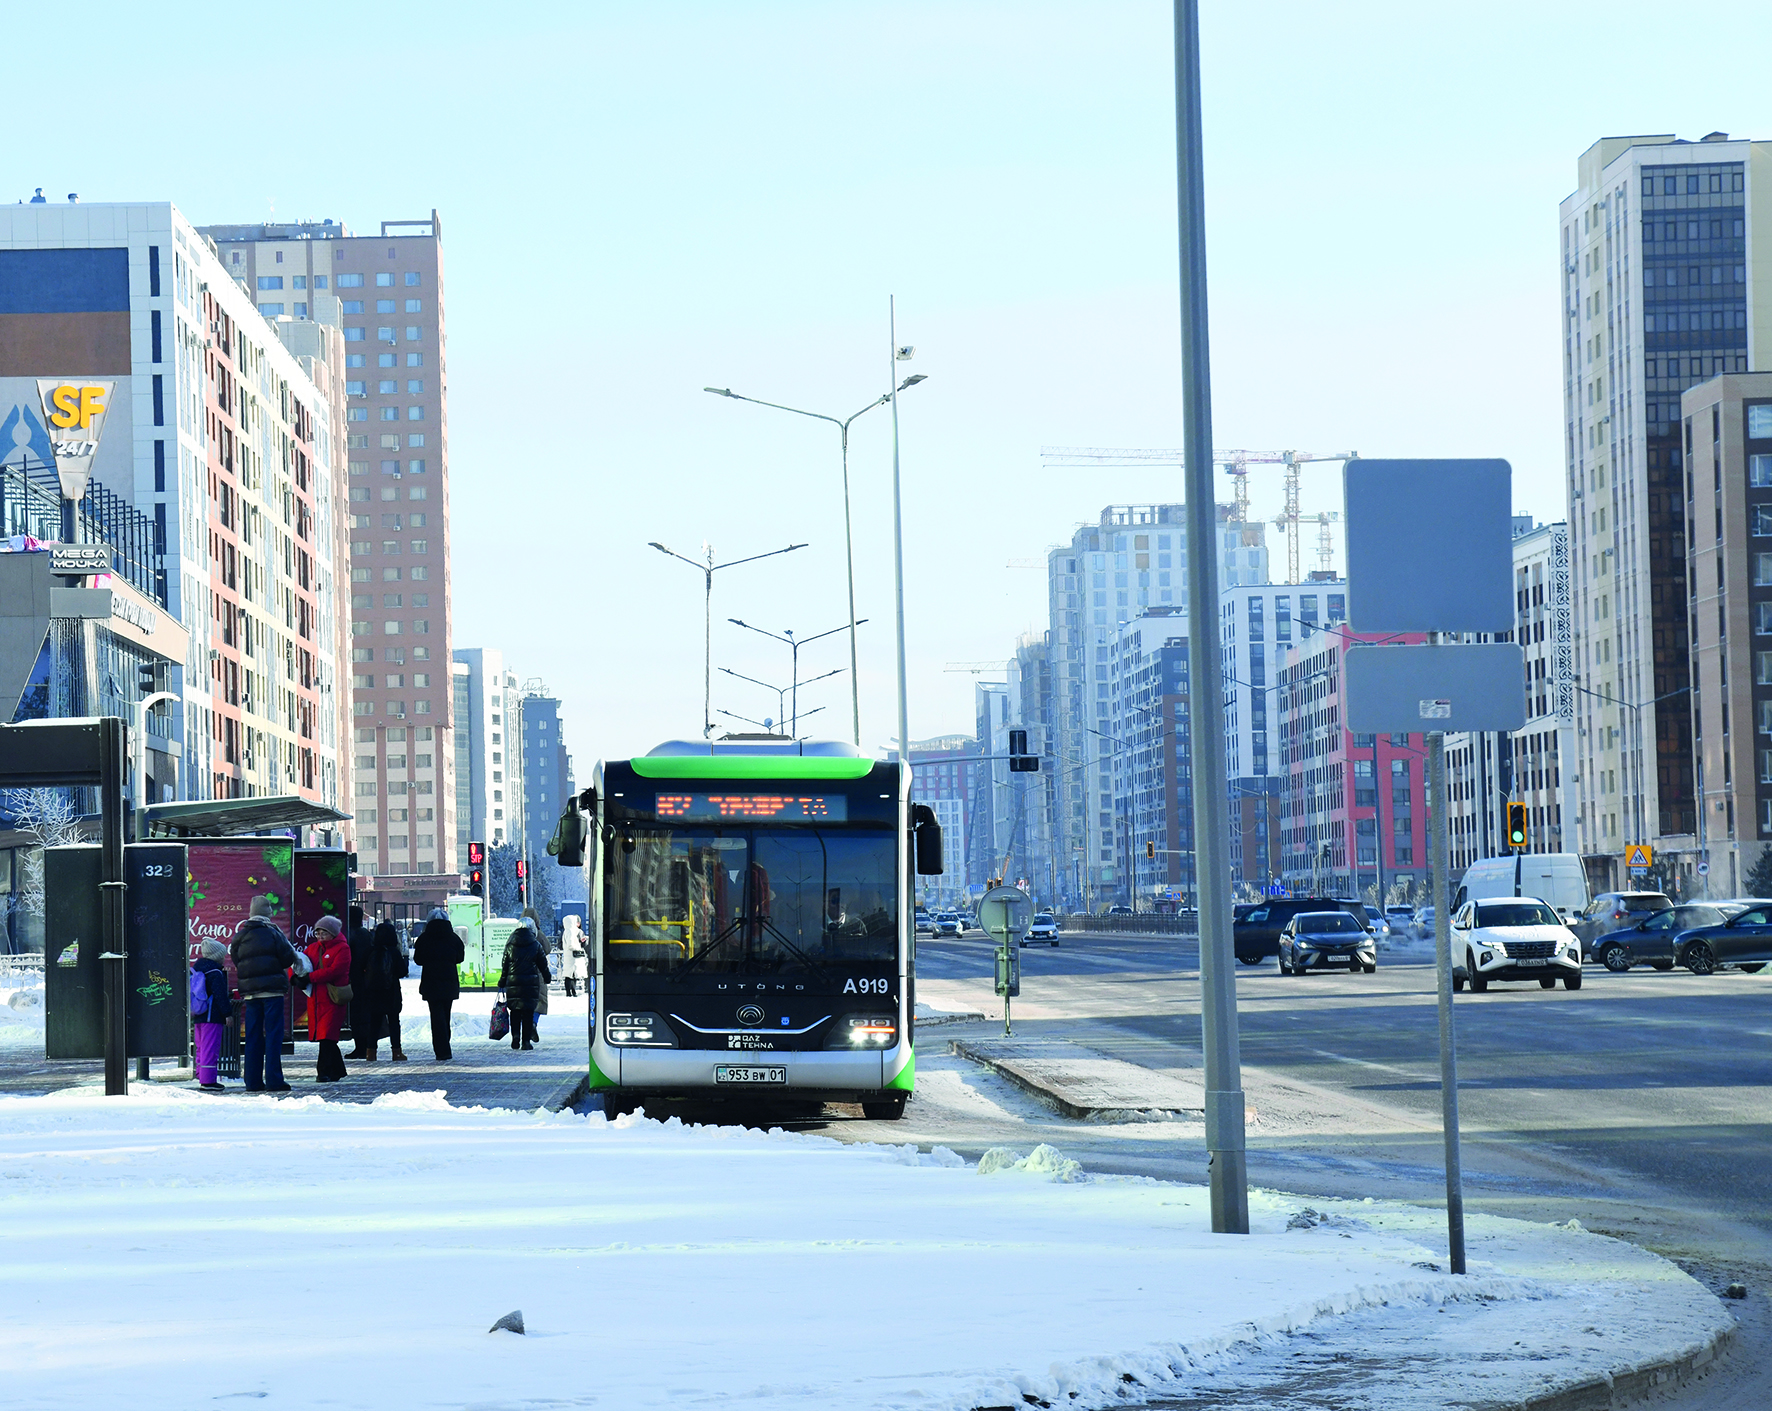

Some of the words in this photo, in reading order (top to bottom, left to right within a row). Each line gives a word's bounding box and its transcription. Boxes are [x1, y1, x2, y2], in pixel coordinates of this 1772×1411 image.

[51, 386, 106, 429] SF
[56, 441, 98, 456] 24/7
[52, 549, 107, 559] MEGA
[728, 1069, 749, 1081] 953
[752, 1071, 766, 1081] BW
[769, 1069, 784, 1081] 01
